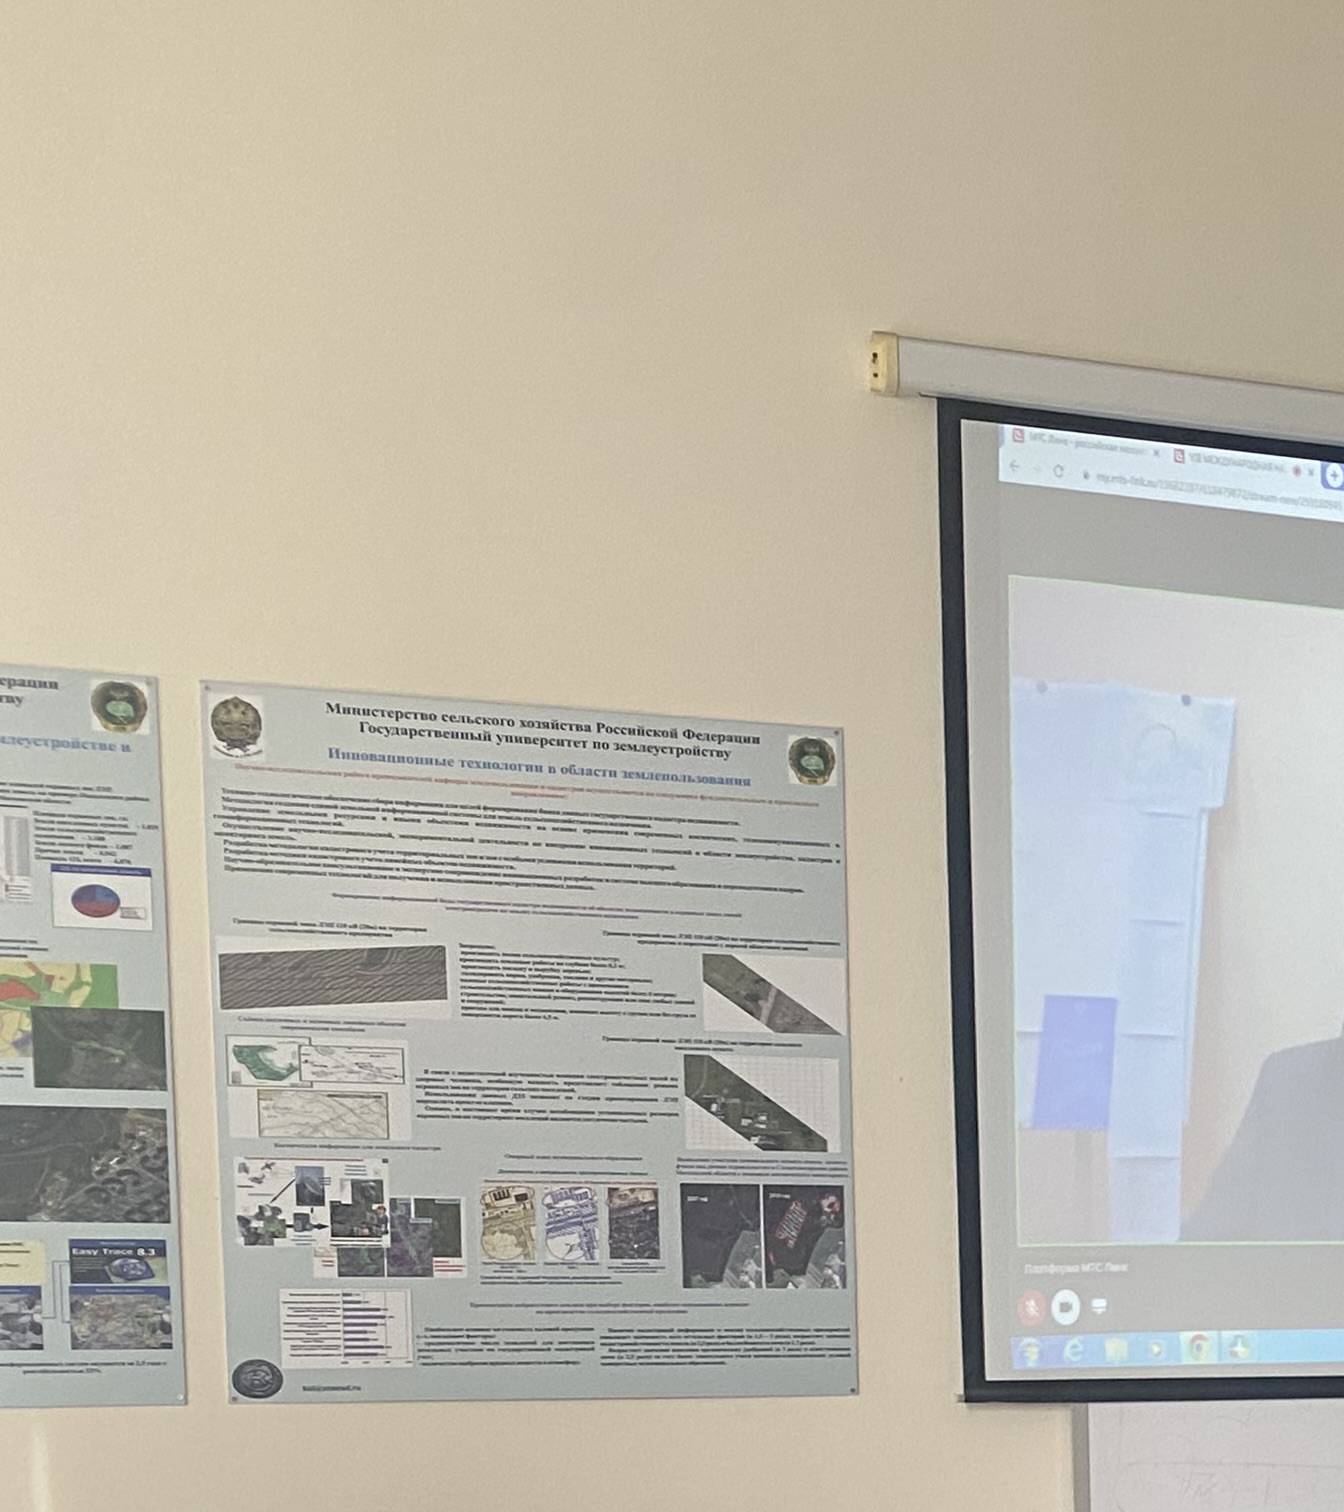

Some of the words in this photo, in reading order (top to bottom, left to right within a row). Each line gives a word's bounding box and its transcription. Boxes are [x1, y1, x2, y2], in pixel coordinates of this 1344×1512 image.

[325, 701, 437, 722] Министерство
[441, 712, 515, 728] сельского
[519, 718, 592, 734] хозяйства
[596, 721, 679, 739] Российской
[682, 727, 761, 746] Федерации
[358, 721, 492, 743] Государственный
[495, 731, 588, 749] университет
[592, 740, 610, 751] по
[613, 741, 732, 762] землеустройству
[328, 747, 455, 768] Инновационные
[459, 758, 544, 774] технологии
[547, 764, 556, 774] в
[560, 763, 618, 779] области
[621, 768, 751, 787] землепользования
[72, 1247, 99, 1256] Easy
[102, 1247, 133, 1256] Trace
[136, 1247, 156, 1257] 8.3
